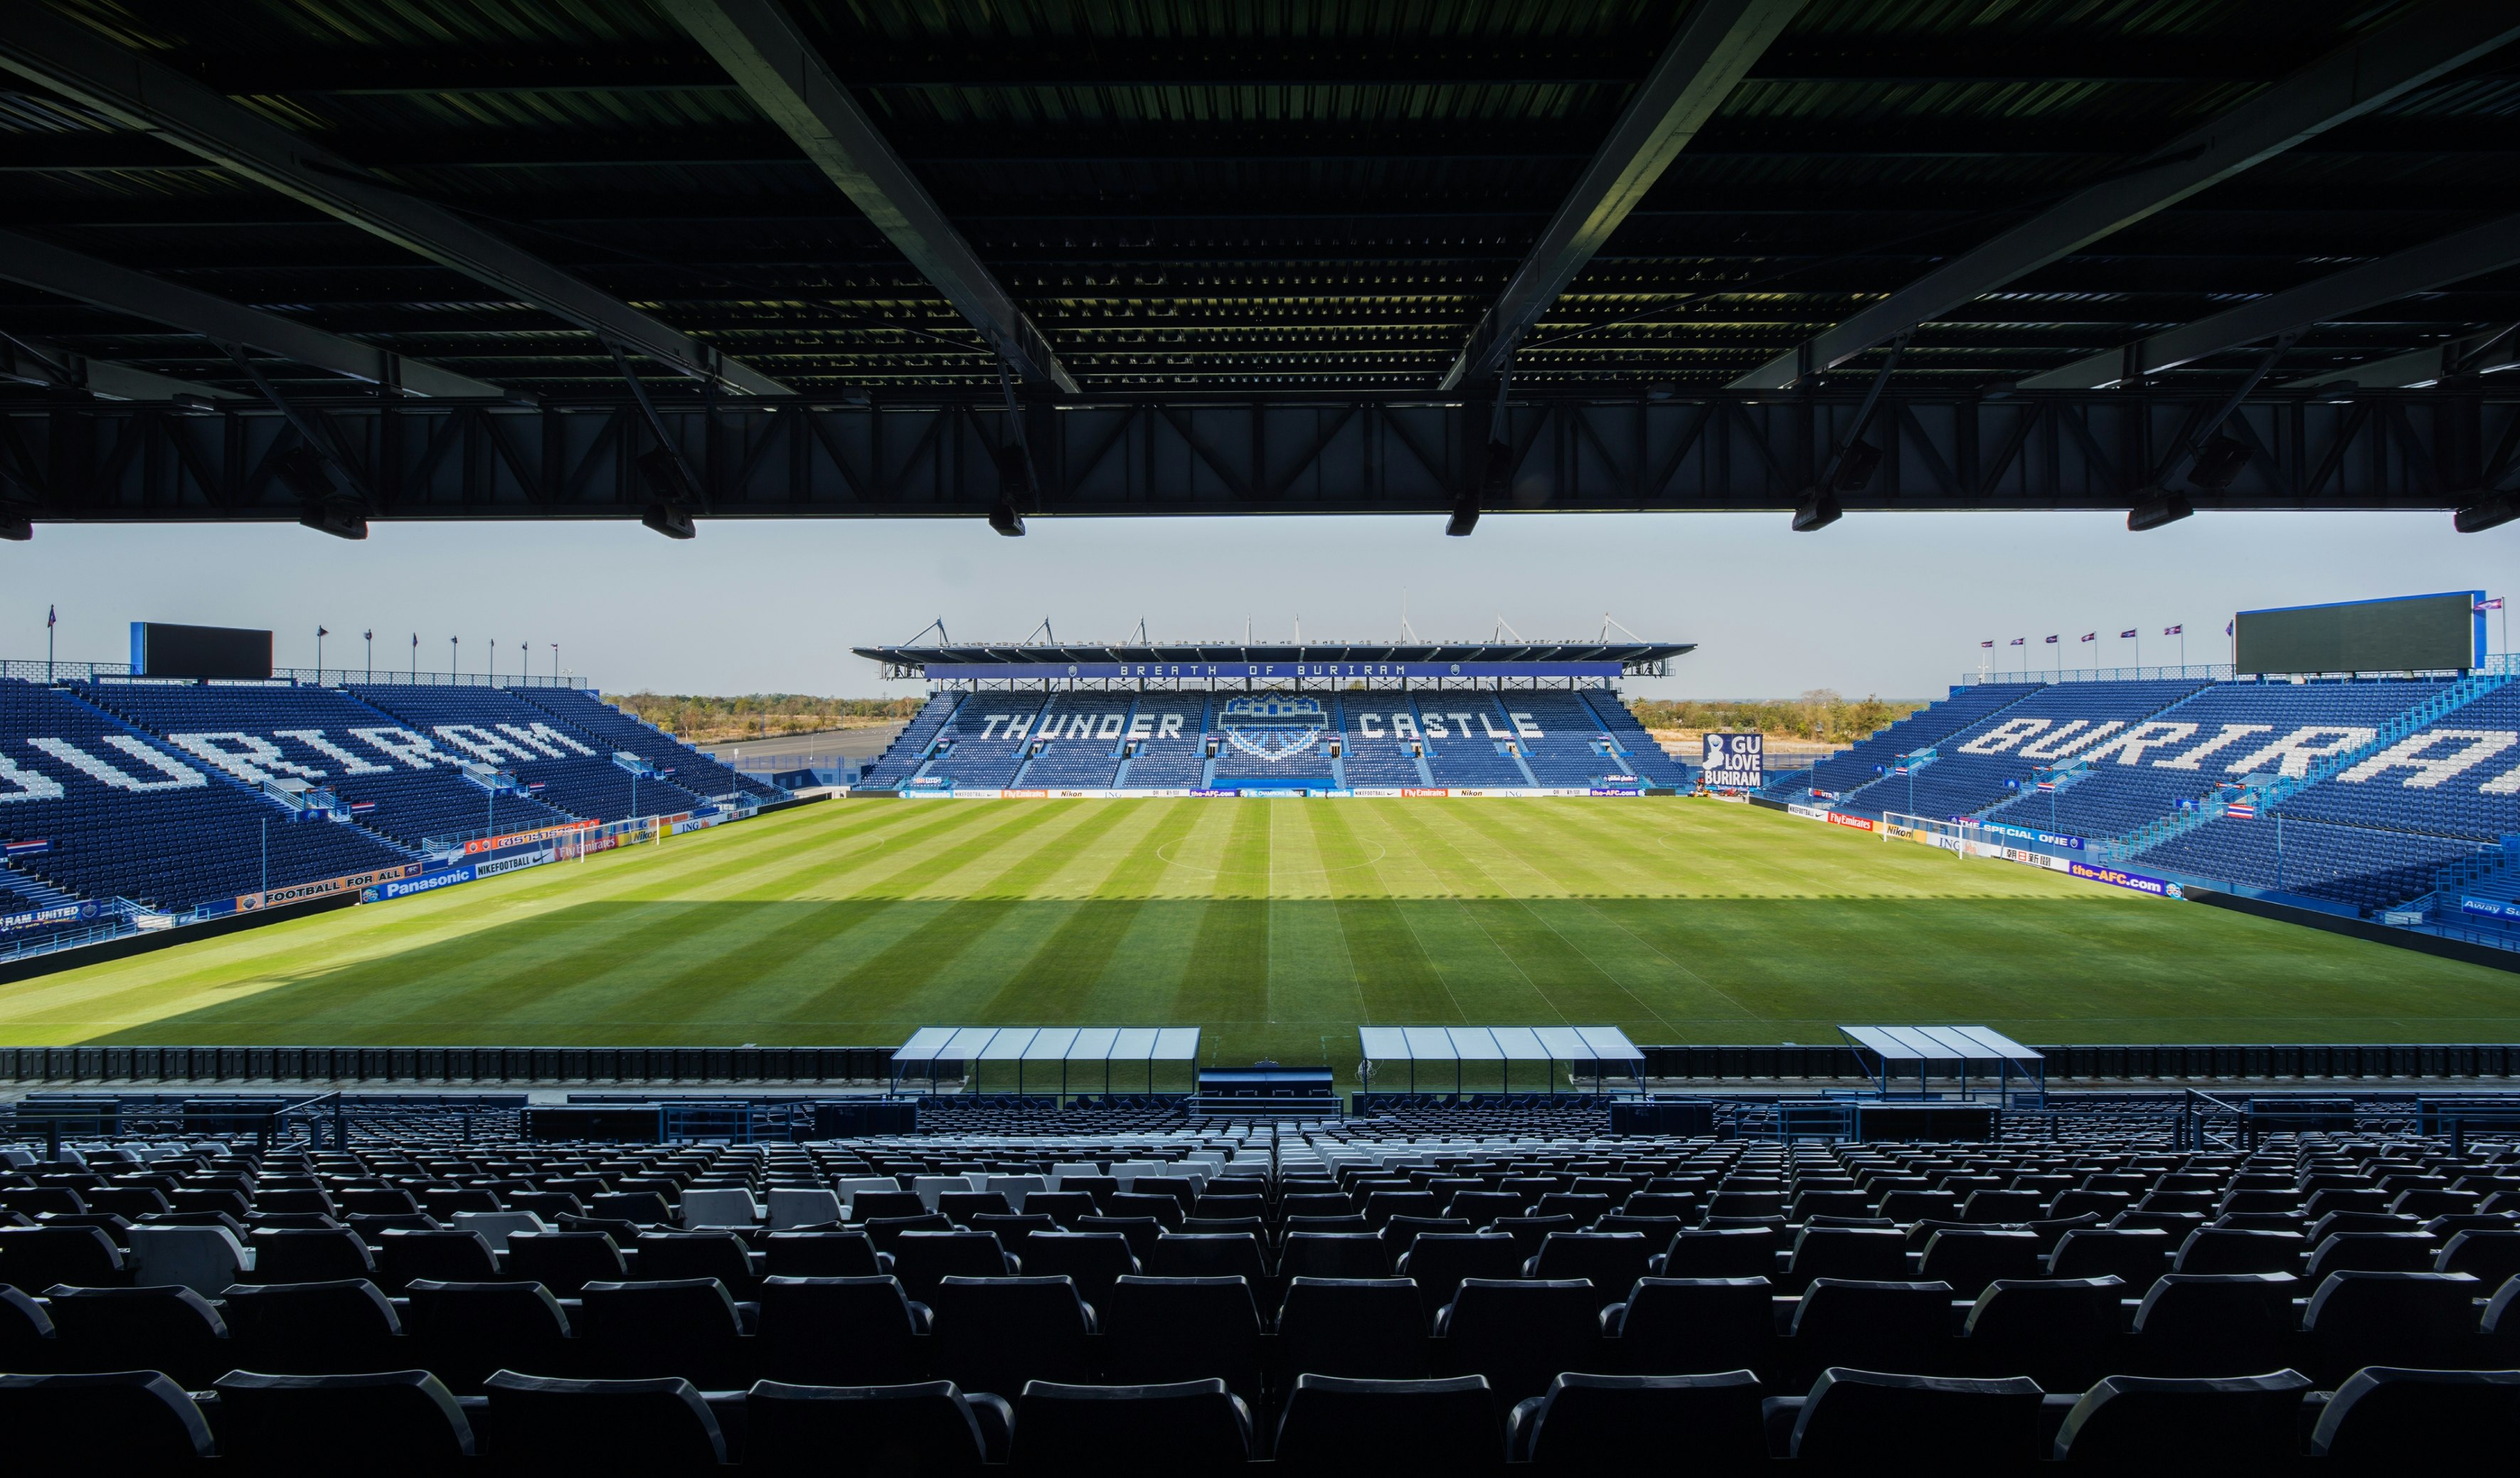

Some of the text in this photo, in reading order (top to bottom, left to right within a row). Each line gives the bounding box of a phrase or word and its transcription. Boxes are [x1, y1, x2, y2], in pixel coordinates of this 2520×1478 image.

[1120, 665, 1405, 675] BREATH OF BURIRAM
[980, 713, 1544, 740] THUNDER CASTLE
[1731, 735, 1760, 754] GU
[1725, 754, 1760, 771] LOVE
[1958, 718, 2520, 794] BURIRA
[1705, 770, 1760, 786] BURIRAM
[1004, 789, 1016, 798] Fly
[1789, 806, 1814, 817] NIKEFOOTBALL
[682, 821, 699, 832] ING
[1830, 812, 1871, 829] Fly Emirates
[634, 829, 658, 841] Nikon
[1886, 825, 1912, 838] Nikon
[1959, 819, 2068, 846] THE SPECIAL ONE
[577, 838, 615, 854] Emirates
[1939, 837, 1960, 851] ING
[477, 856, 530, 876] NIKEFOOTBALL
[266, 869, 402, 904] FOOTBALL FOR ALL
[387, 869, 469, 898] Panasonic
[2071, 864, 2162, 893] the-AFC.com
[37, 906, 79, 920] UNITED
[2464, 900, 2500, 914] Away
